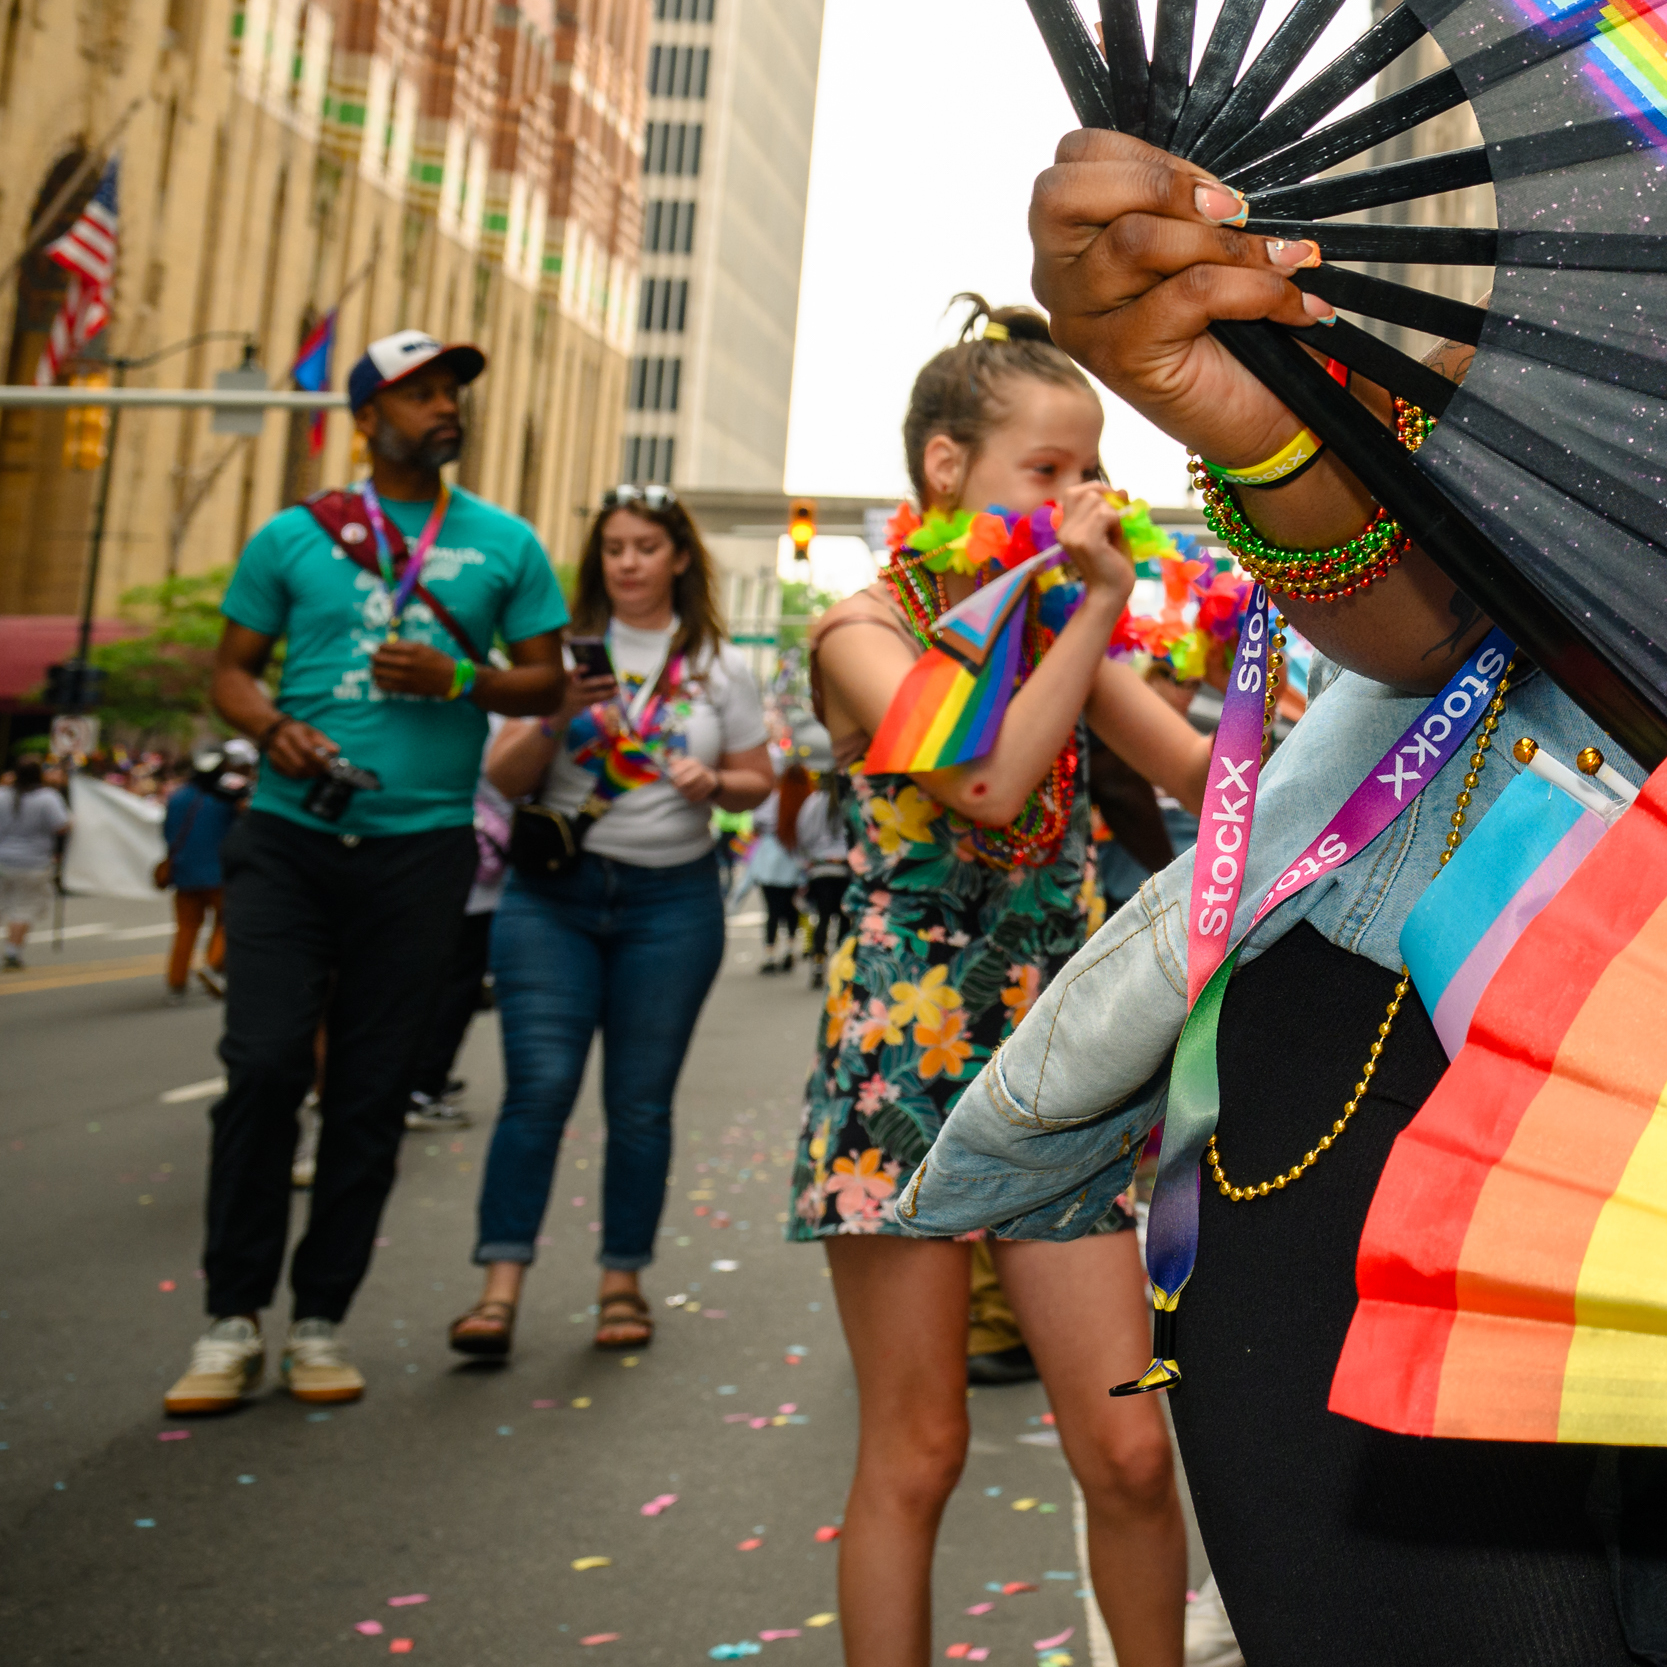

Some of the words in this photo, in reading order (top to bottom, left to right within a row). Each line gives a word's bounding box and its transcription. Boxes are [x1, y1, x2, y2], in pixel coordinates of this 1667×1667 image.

[1221, 448, 1308, 484] StockX
[1376, 646, 1505, 802] StockX
[1198, 755, 1255, 937] StockX
[1250, 832, 1348, 926] Stoc
